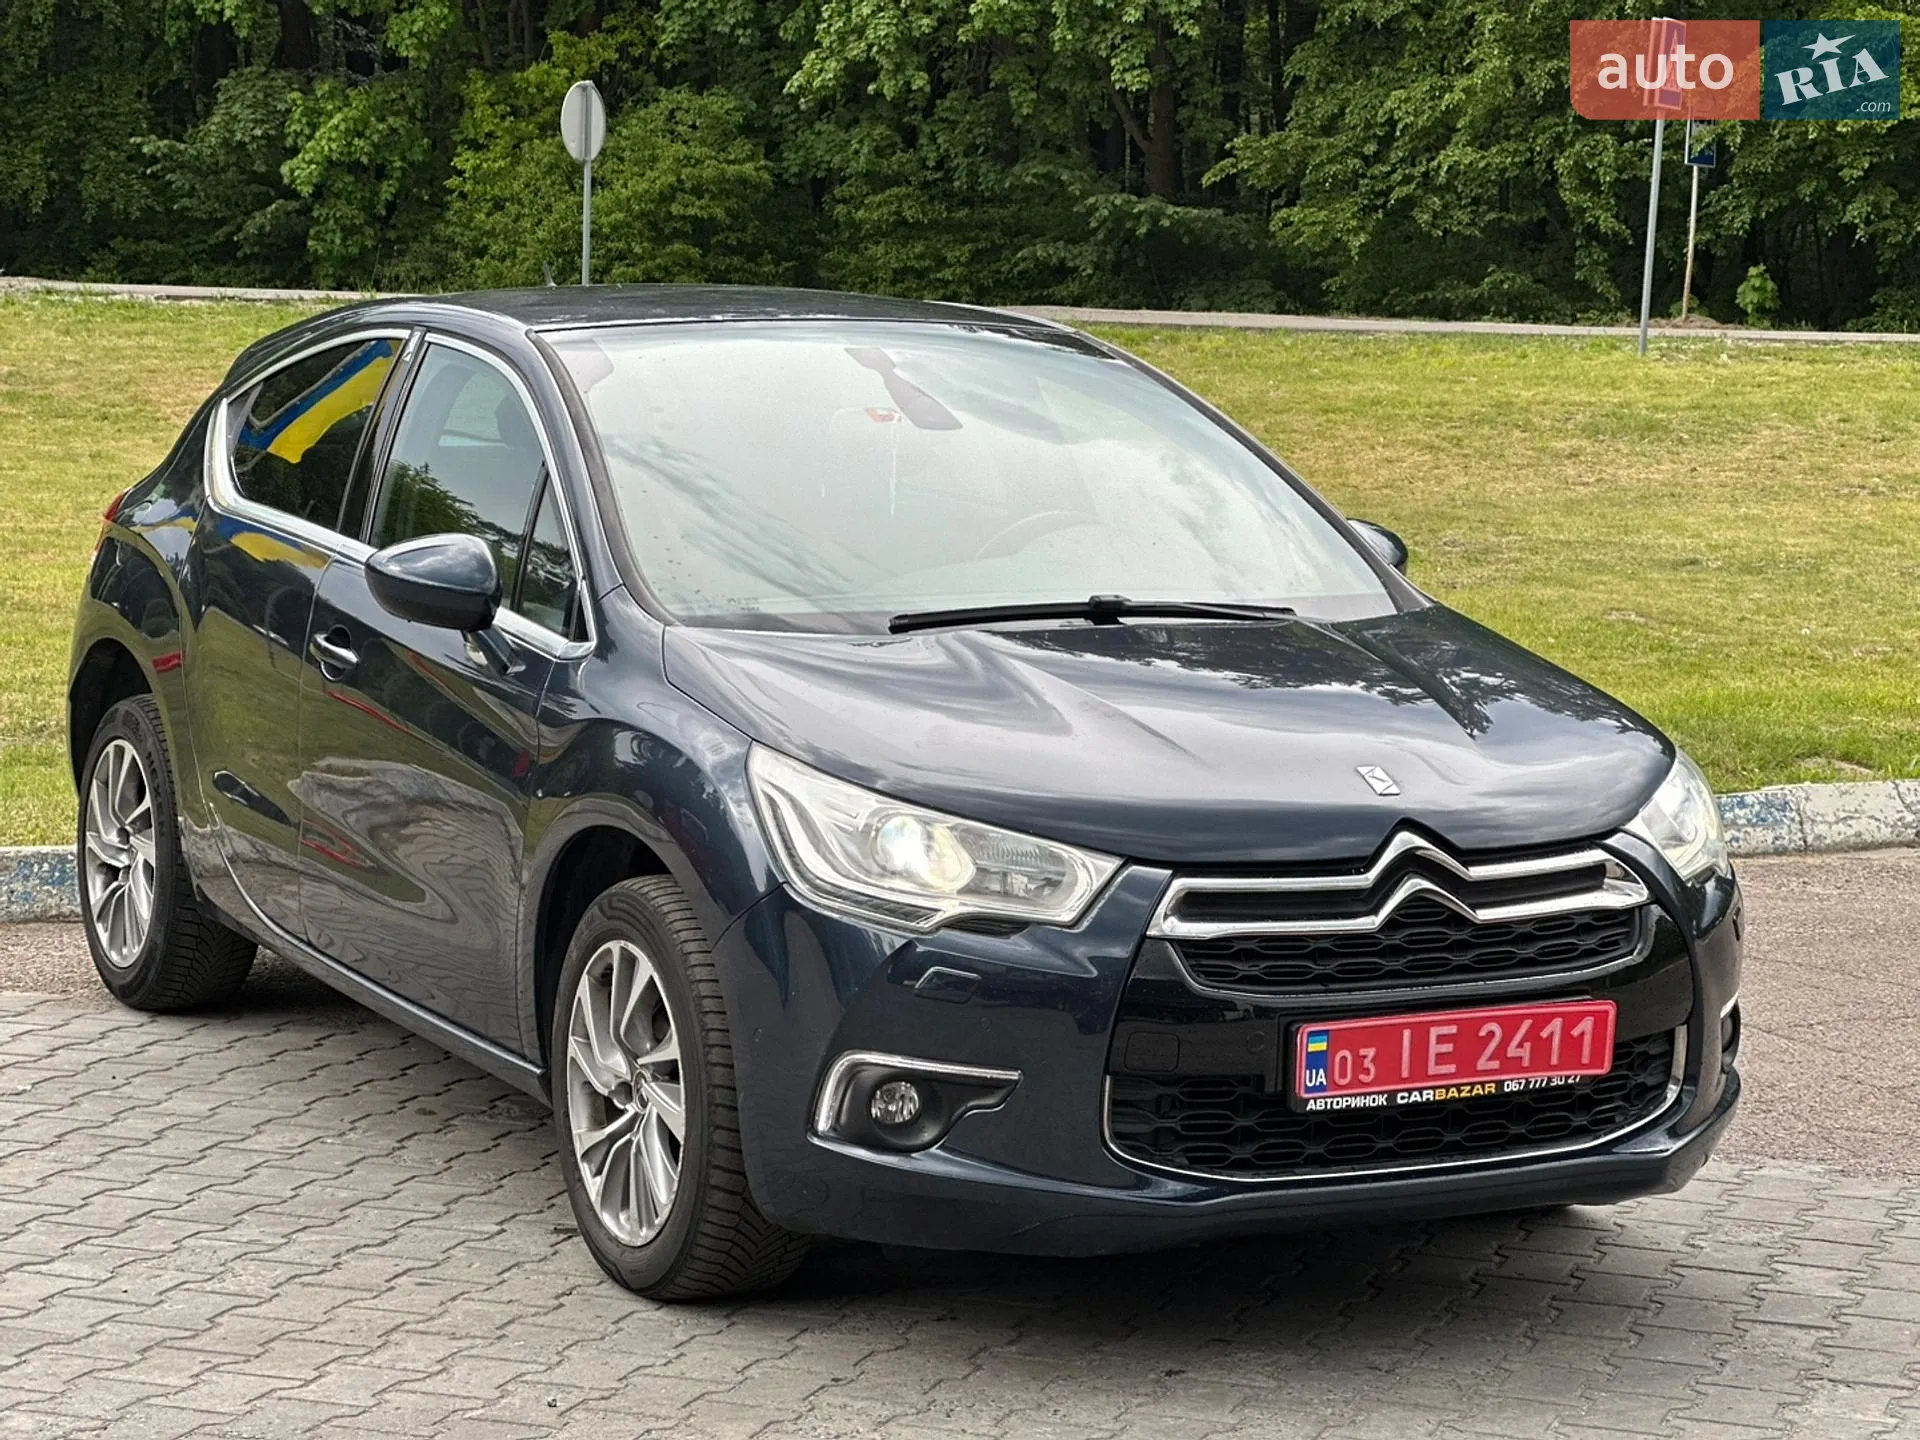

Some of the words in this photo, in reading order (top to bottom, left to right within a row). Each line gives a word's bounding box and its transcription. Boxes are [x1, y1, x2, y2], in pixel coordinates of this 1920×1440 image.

[1333, 1047, 1377, 1086] 03
[1400, 1024, 1458, 1079] IE
[1475, 1015, 1595, 1072] 2411
[1305, 1068, 1328, 1087] UA
[1305, 1093, 1388, 1111] АВТОРИНОК
[1396, 1082, 1496, 1104] CARBAZAR
[1503, 1079, 1526, 1092] 067
[1528, 1076, 1548, 1089] 777
